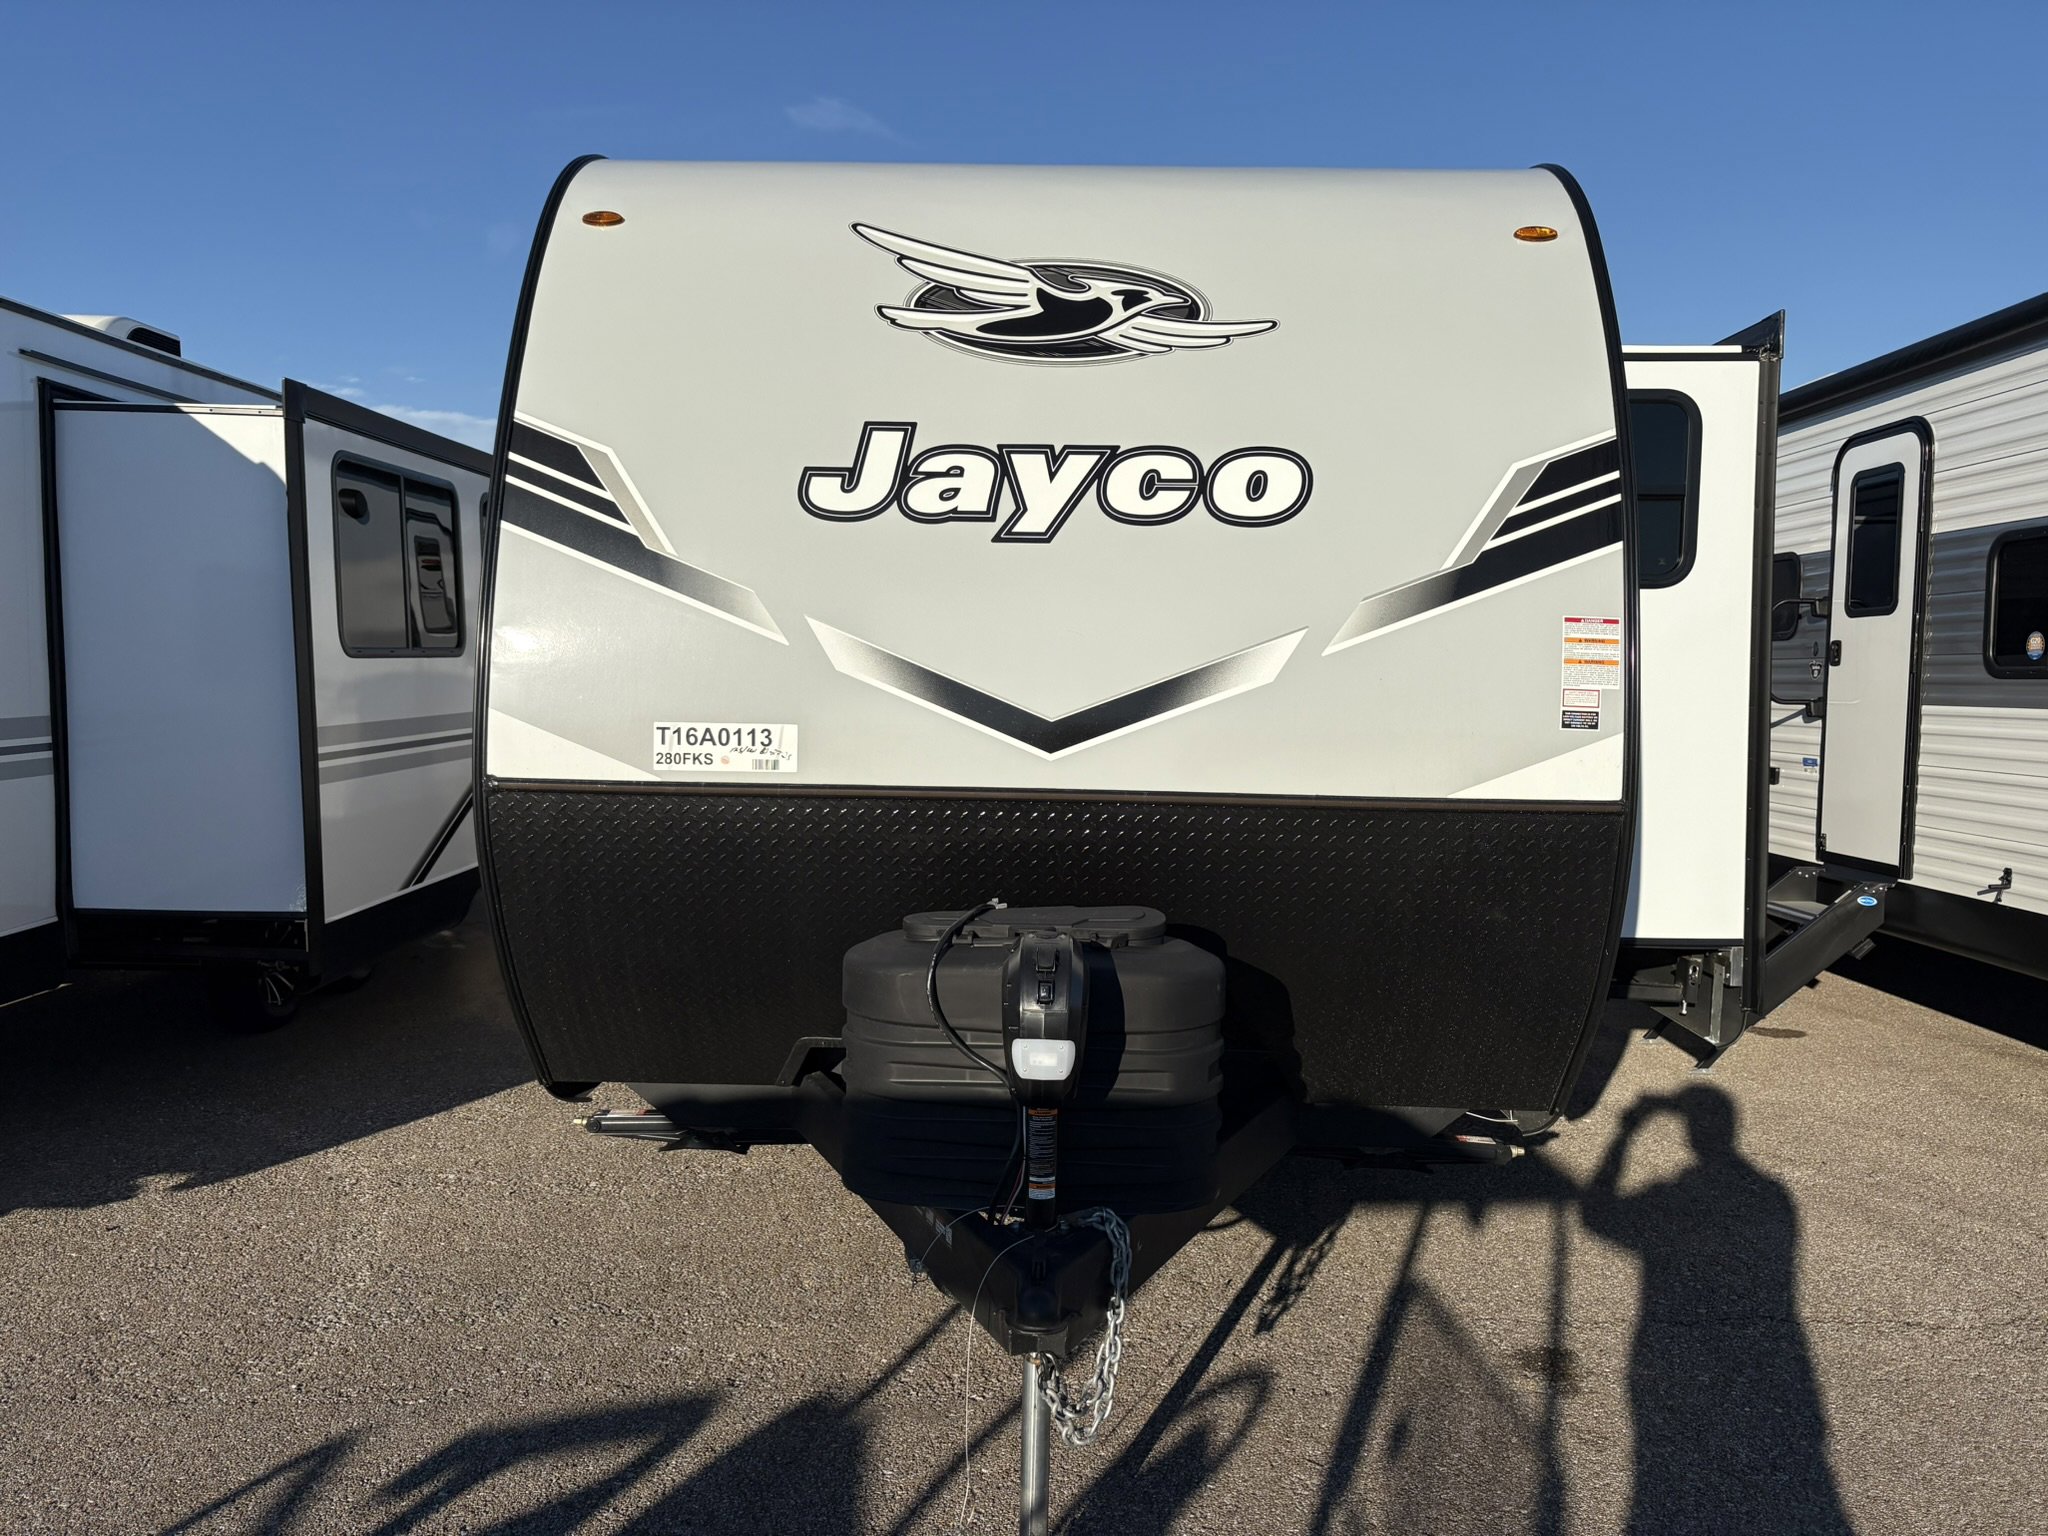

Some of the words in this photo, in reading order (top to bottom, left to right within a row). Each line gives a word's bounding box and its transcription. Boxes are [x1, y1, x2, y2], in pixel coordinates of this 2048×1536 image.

[797, 421, 1314, 543] Jayco
[656, 726, 773, 747] T16A0113
[655, 752, 714, 765] 280FKS
